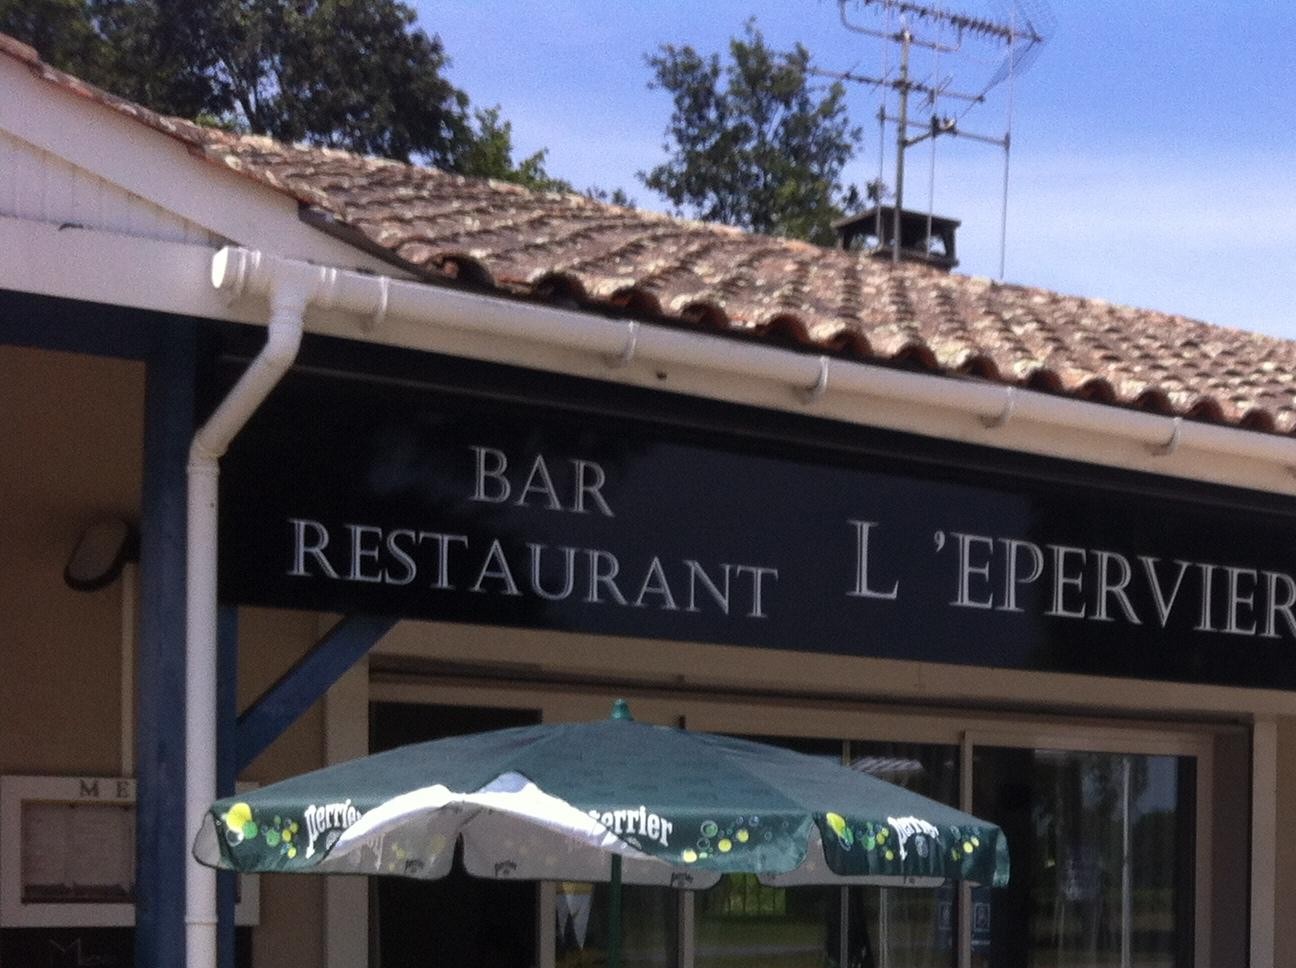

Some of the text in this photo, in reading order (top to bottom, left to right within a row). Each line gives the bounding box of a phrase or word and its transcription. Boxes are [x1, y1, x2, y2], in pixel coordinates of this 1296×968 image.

[468, 445, 616, 518] BAR
[287, 518, 780, 619] RESTAURANT
[845, 519, 900, 601] L
